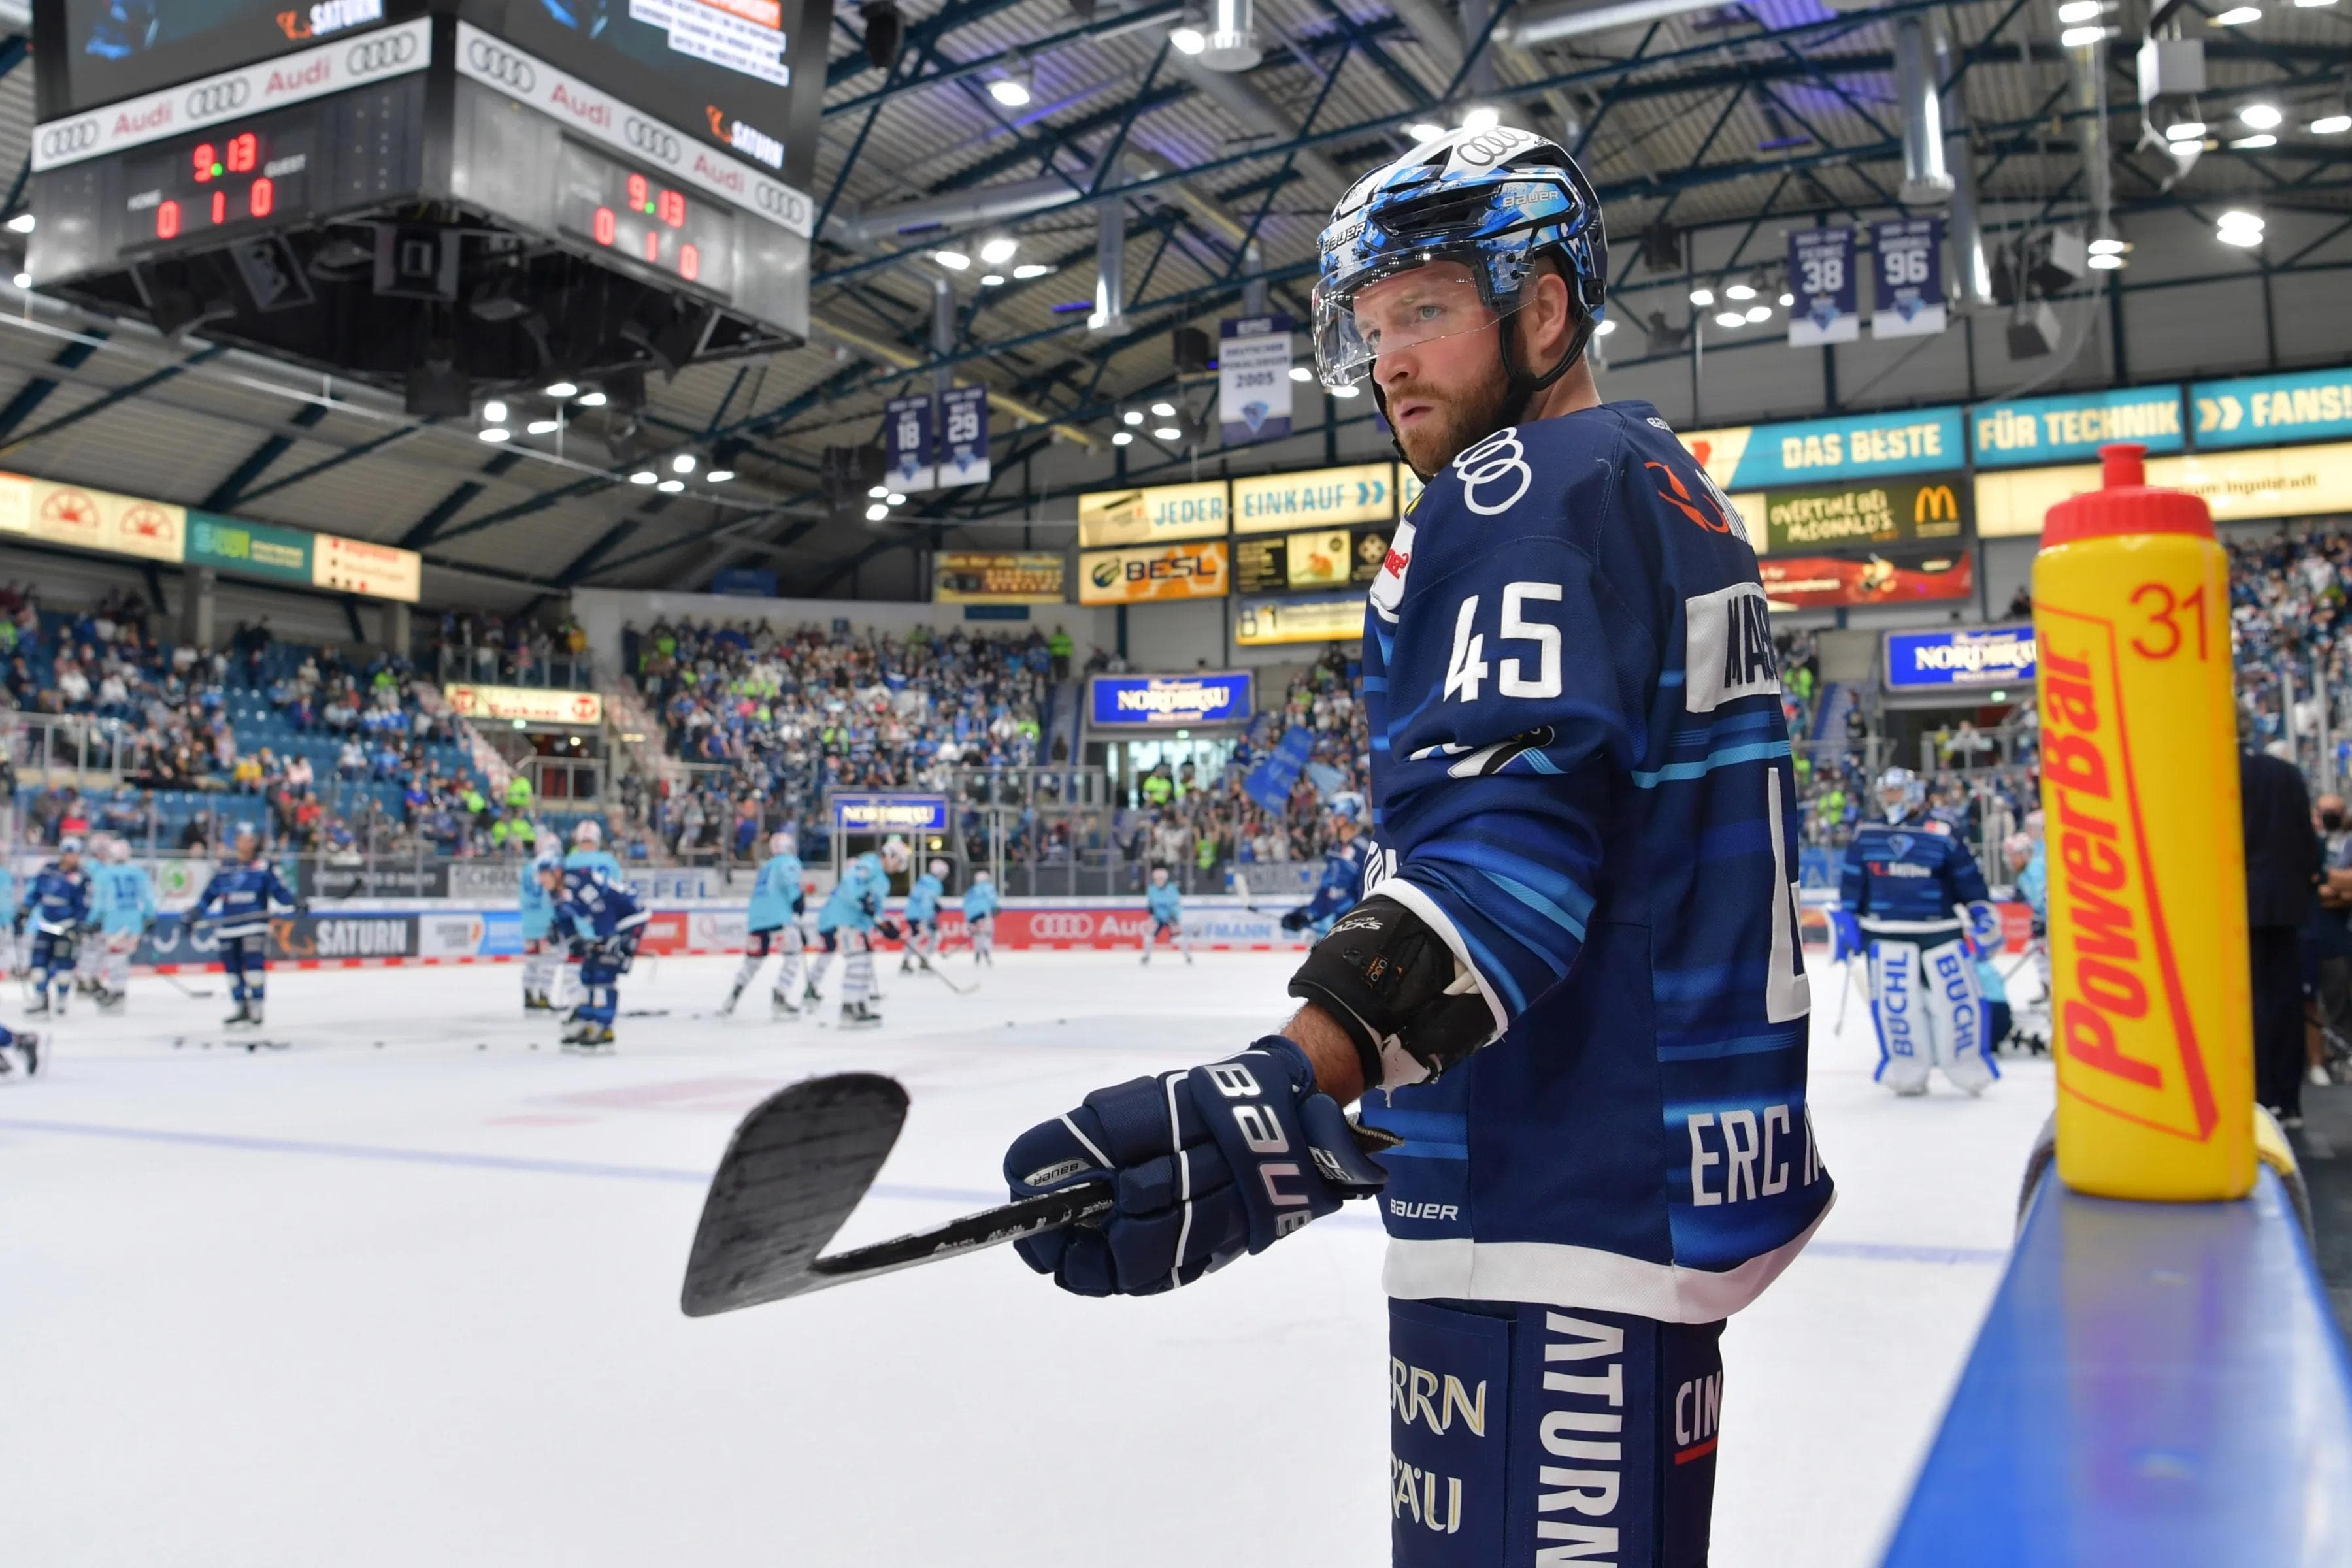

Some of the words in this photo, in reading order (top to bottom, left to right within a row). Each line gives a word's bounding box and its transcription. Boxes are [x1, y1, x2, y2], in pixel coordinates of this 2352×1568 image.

[266, 56, 331, 91] Audi
[112, 101, 173, 137] Audi
[552, 84, 612, 128] Audi
[695, 155, 744, 193] Audi
[157, 200, 180, 240] 0
[250, 177, 273, 218] 0
[594, 207, 615, 246] 0
[680, 244, 699, 281] 0
[1802, 259, 1844, 294] 38
[1885, 250, 1929, 286] 96
[897, 420, 921, 451] 18
[948, 412, 980, 444] 29
[1782, 433, 1843, 470] DAS
[1851, 423, 1942, 464] BESTE
[1978, 408, 2038, 451] FÜR
[2043, 400, 2181, 446] TECHNIK
[1155, 497, 1224, 527] JEDER
[1244, 483, 1345, 517] EINKAUF
[1125, 555, 1217, 582] BESL
[1443, 581, 1563, 703] 45
[2128, 581, 2208, 662] 31
[2040, 632, 2164, 1092] PowerBar
[316, 919, 407, 956] SATURN
[1687, 1103, 1791, 1207] ERC
[1389, 1198, 1459, 1222] BAUER
[1674, 1369, 1723, 1446] CIN
[1536, 1310, 1624, 1568] ATURN
